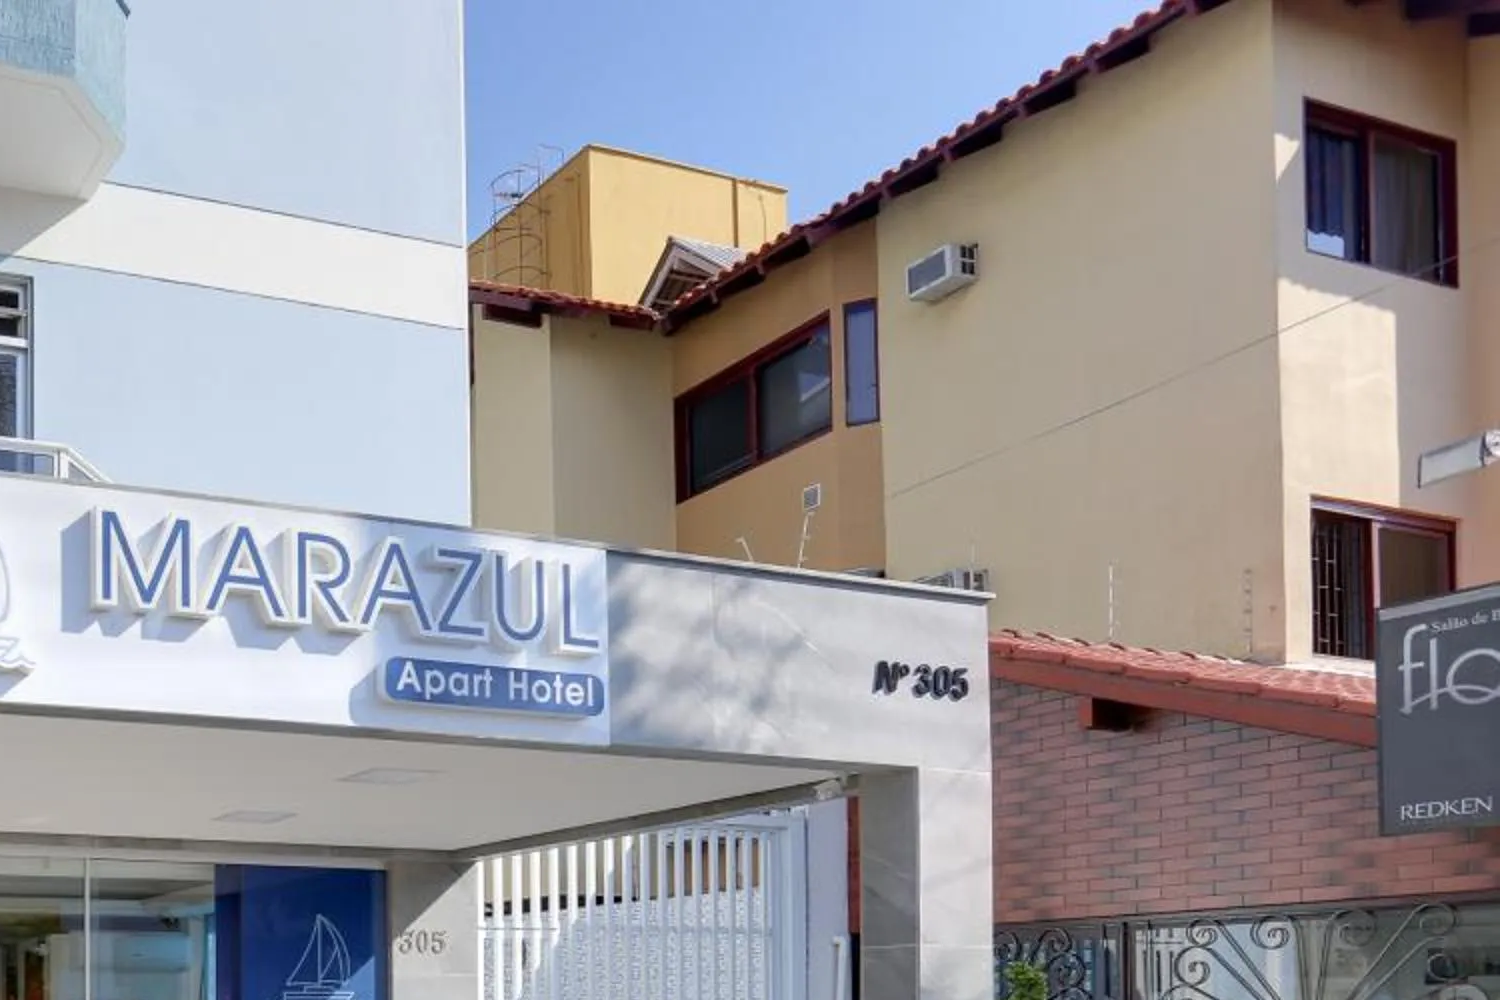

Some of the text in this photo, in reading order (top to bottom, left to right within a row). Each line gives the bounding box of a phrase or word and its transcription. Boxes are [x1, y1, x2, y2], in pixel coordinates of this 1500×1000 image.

[97, 506, 601, 654] MARAZUL
[396, 660, 595, 707] Apart Hotel
[912, 663, 969, 702] 305
[1400, 796, 1492, 821] REDKEN
[397, 929, 446, 955] 305
